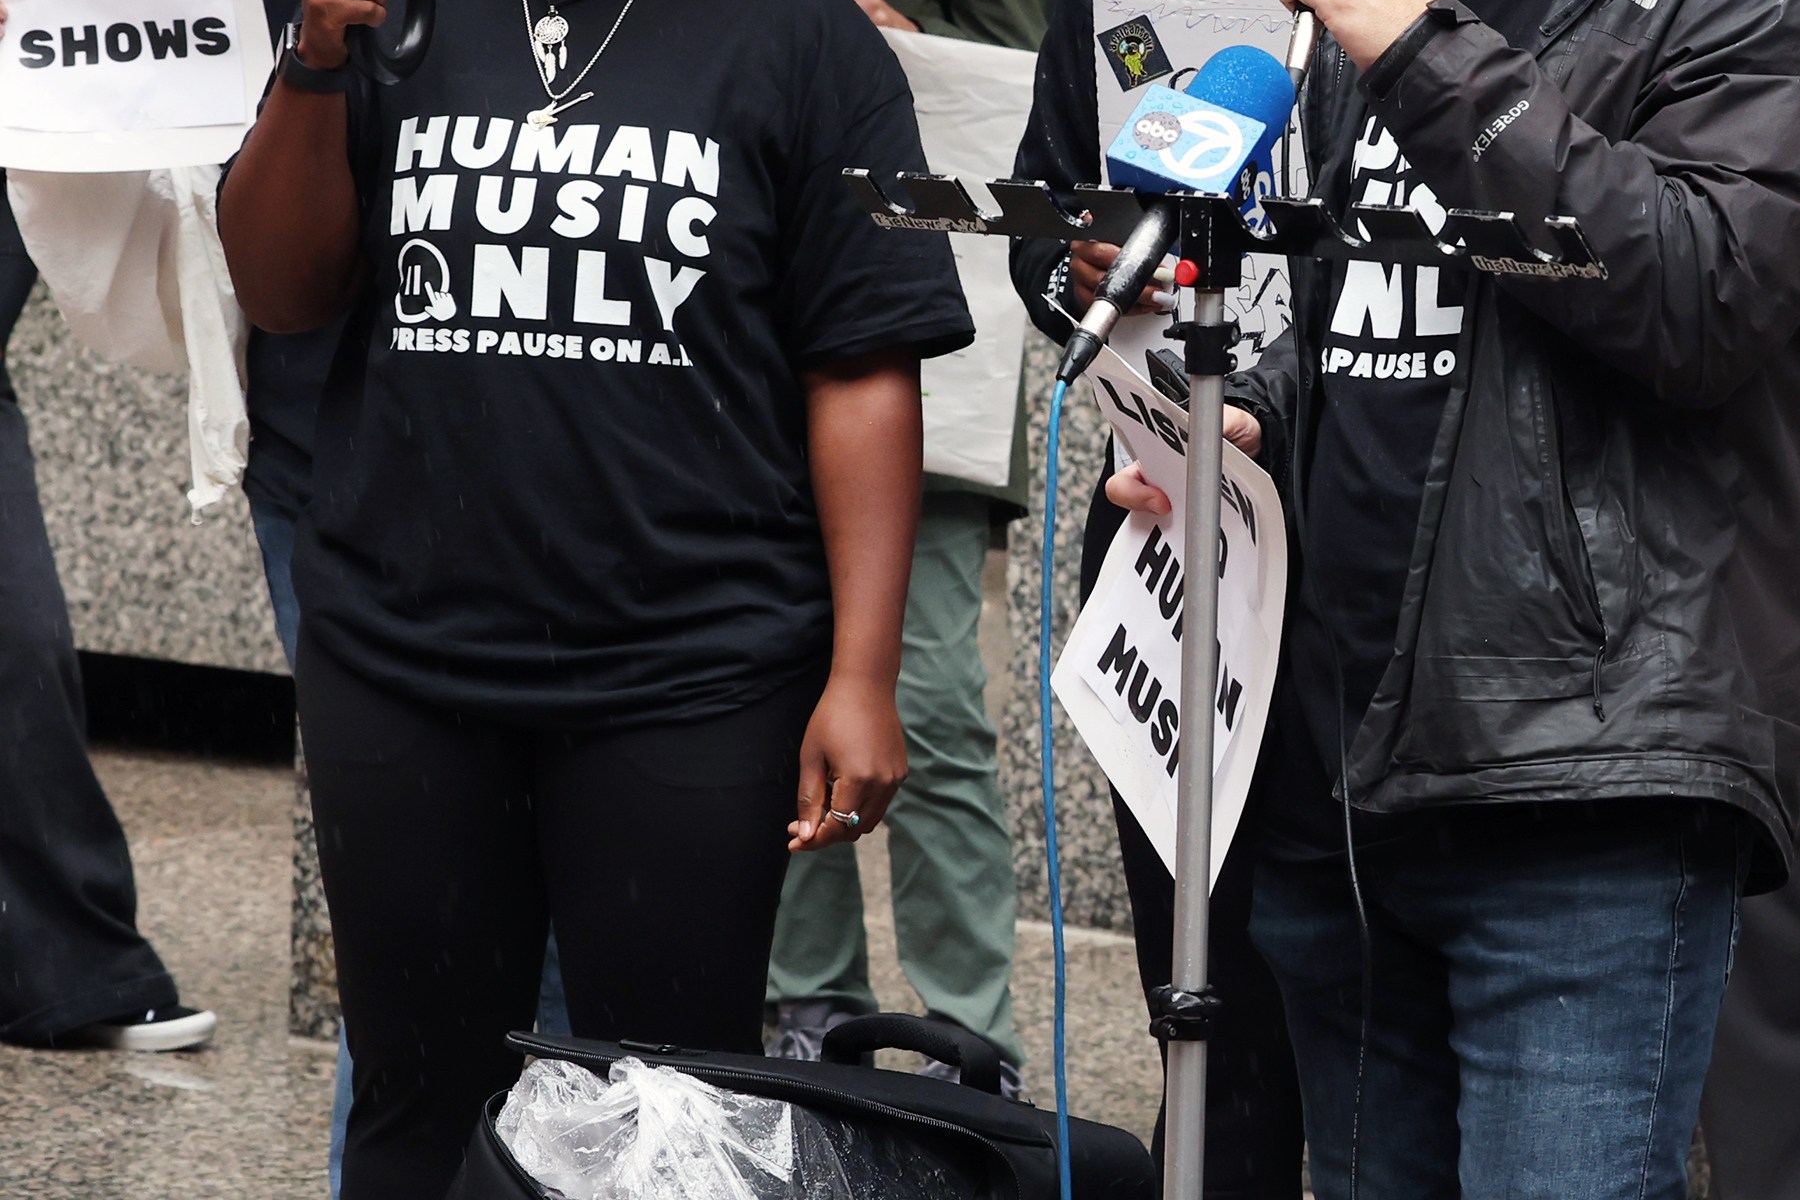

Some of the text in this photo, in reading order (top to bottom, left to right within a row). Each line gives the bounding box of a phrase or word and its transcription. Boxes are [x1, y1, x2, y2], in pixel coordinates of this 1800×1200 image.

[19, 17, 231, 68] SHOWS
[1136, 119, 1178, 142] abc
[394, 115, 720, 197] HUMAN
[390, 174, 718, 257] MUSIC
[476, 329, 583, 359] PAUSE
[589, 337, 642, 363] ON
[1327, 347, 1426, 379] PAUSE
